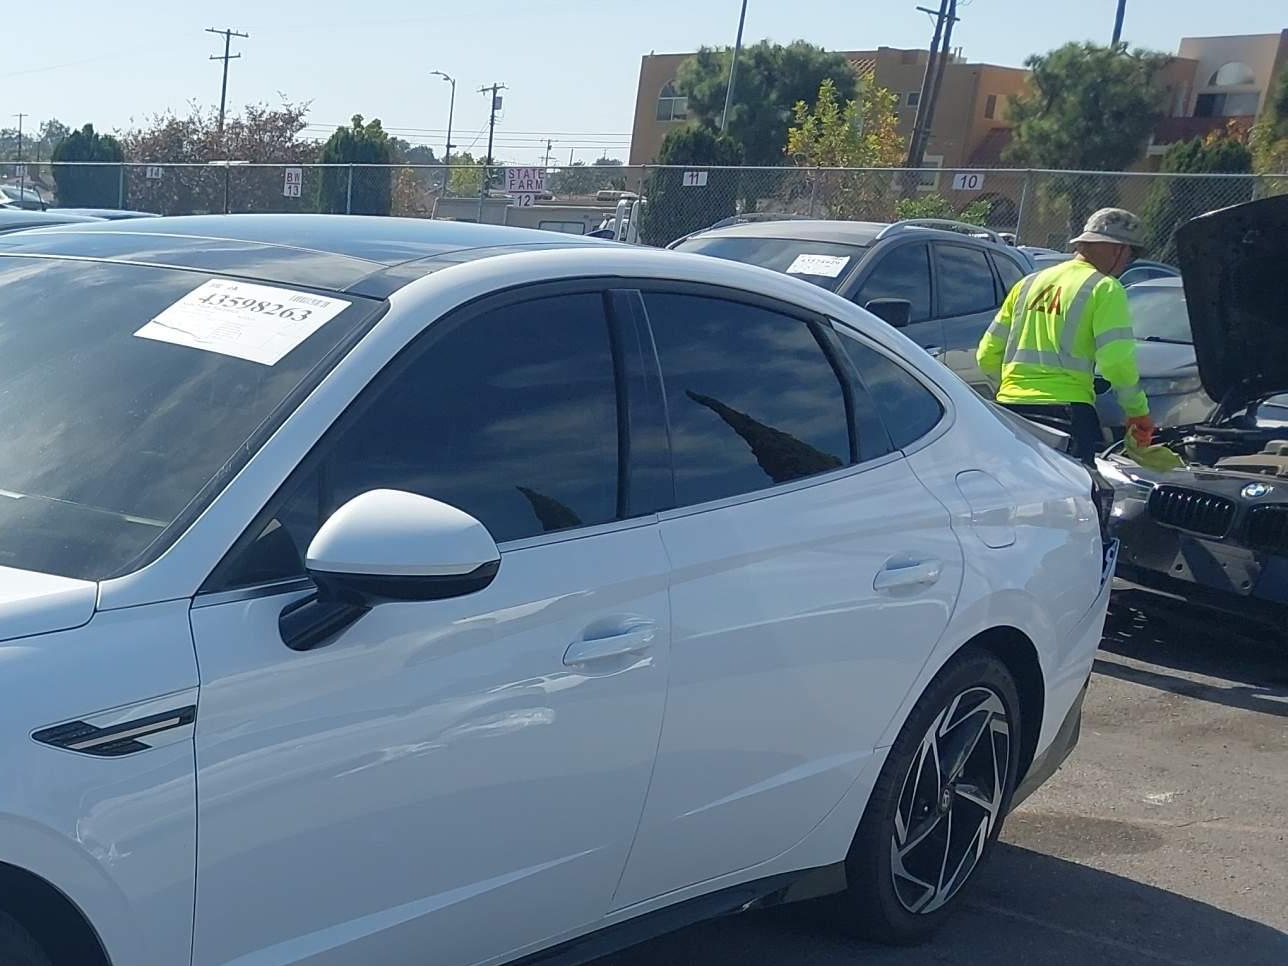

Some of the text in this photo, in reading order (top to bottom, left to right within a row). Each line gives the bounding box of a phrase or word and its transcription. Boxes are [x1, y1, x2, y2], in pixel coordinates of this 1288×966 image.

[508, 168, 544, 179] STATE
[689, 173, 699, 185] 11
[509, 179, 543, 190] FARM
[960, 175, 978, 189] 10
[287, 185, 299, 196] 13
[517, 195, 531, 207] 12
[198, 292, 313, 322] 43598263
